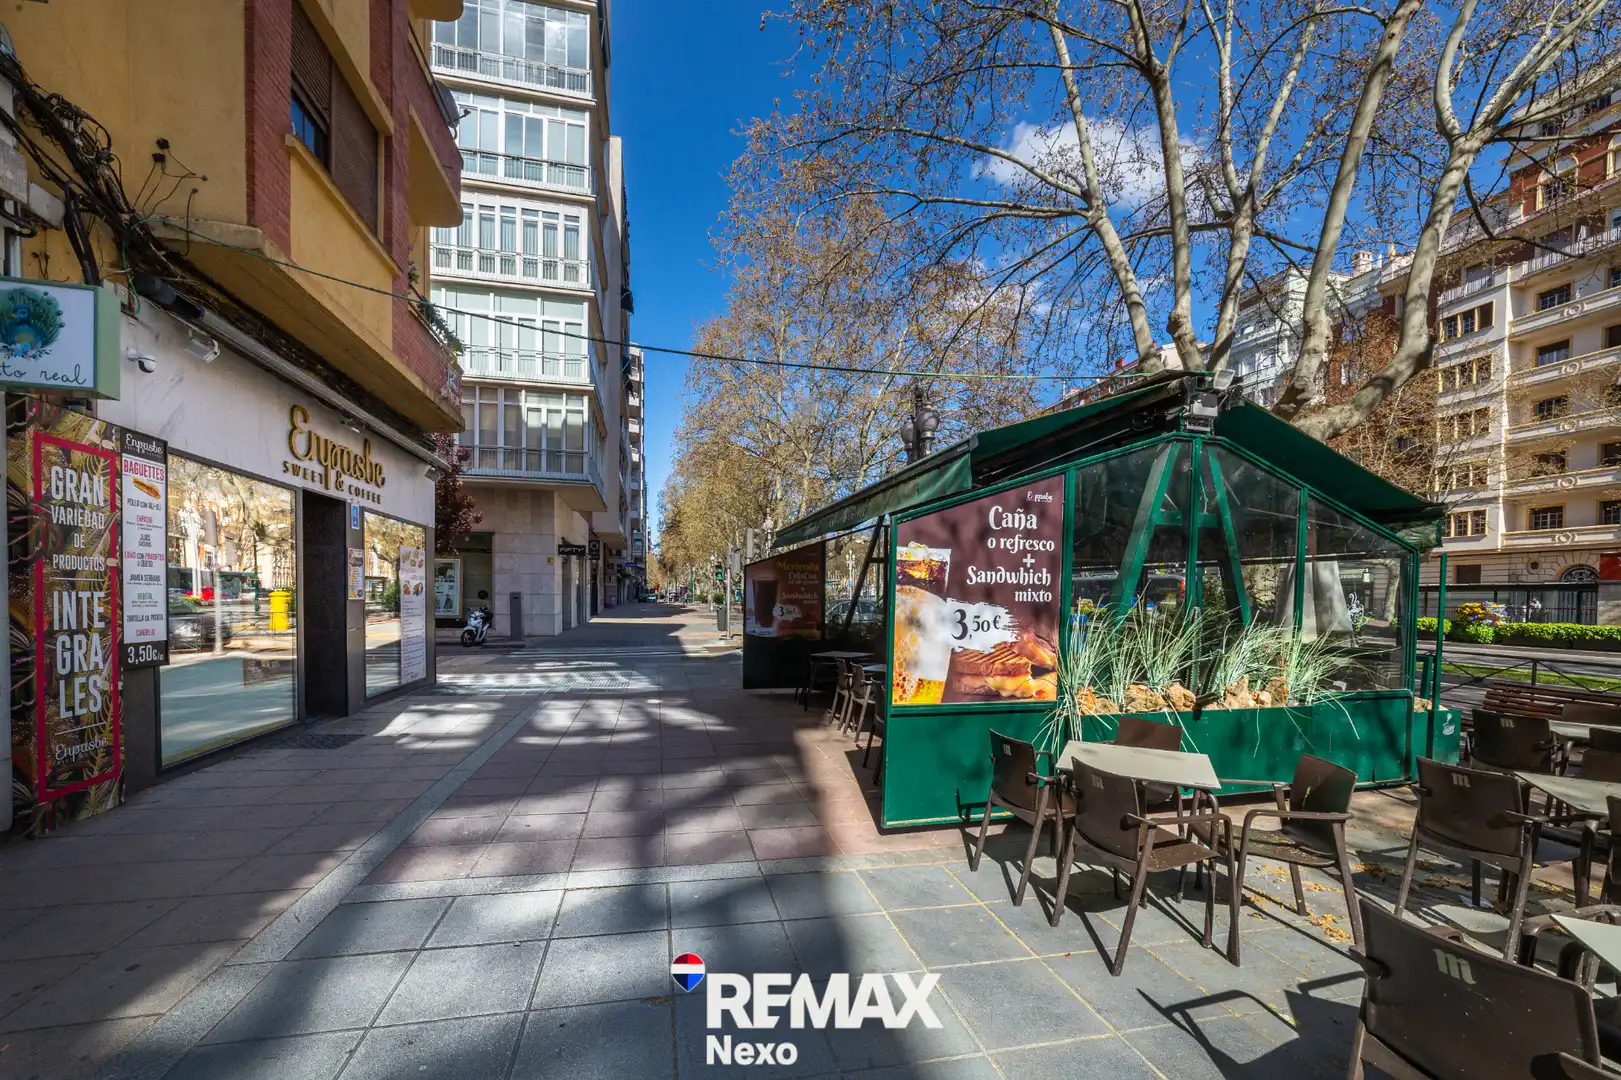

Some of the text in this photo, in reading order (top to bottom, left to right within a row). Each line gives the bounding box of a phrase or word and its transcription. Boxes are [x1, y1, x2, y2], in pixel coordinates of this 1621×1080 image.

[0, 362, 87, 385] to real
[124, 459, 165, 481] BAGUETTES
[51, 466, 105, 507] GRAN
[335, 470, 344, 492] &
[348, 484, 382, 504] COFFEE
[52, 505, 105, 530] VARIEDAD
[988, 506, 1037, 530] Caña
[74, 533, 85, 548] DE
[988, 534, 1055, 554] o refresco
[52, 554, 105, 572] PRODUCTOS
[966, 566, 1052, 586] Sandwhich
[1014, 588, 1052, 602] mixto
[54, 590, 105, 630] INTE
[56, 632, 104, 675] GRA
[60, 675, 102, 719] LES
[1432, 948, 1476, 984] m
